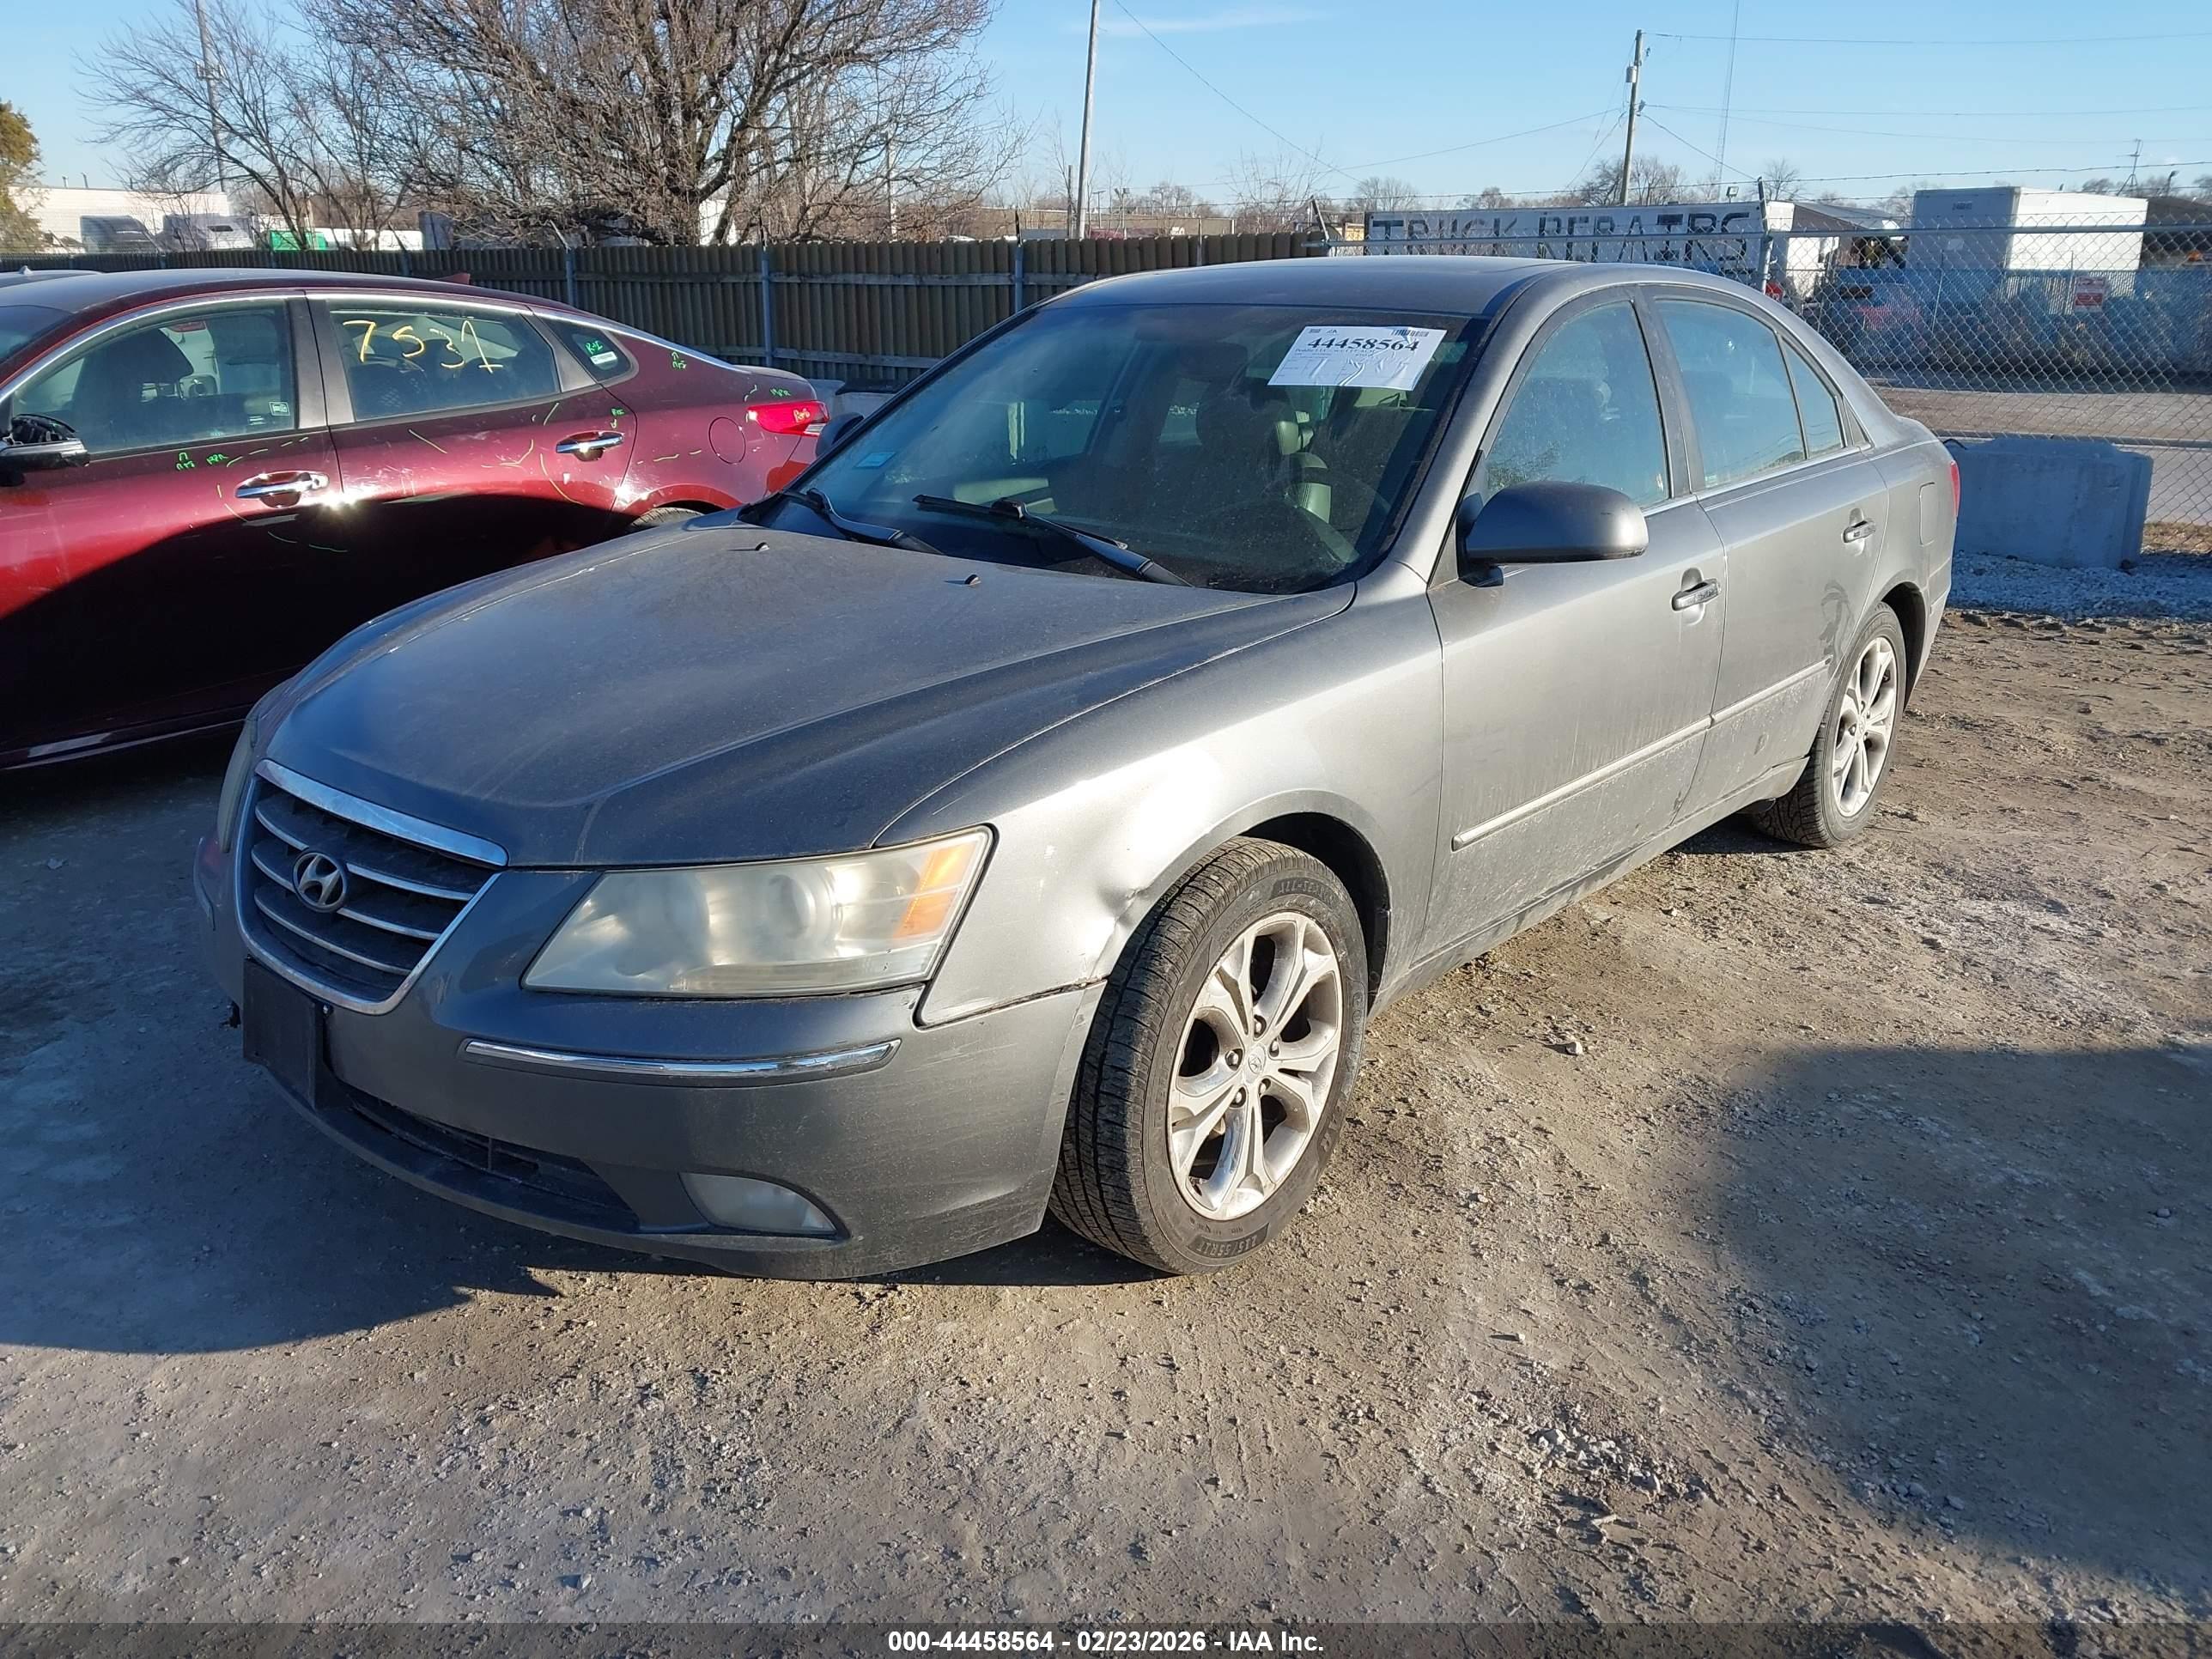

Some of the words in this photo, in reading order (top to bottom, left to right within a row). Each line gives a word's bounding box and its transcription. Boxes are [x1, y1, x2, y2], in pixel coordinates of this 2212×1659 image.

[1372, 216, 1517, 255] TRUCK
[1536, 212, 1749, 262] REPAIRS
[1308, 337, 1419, 351] 44458564
